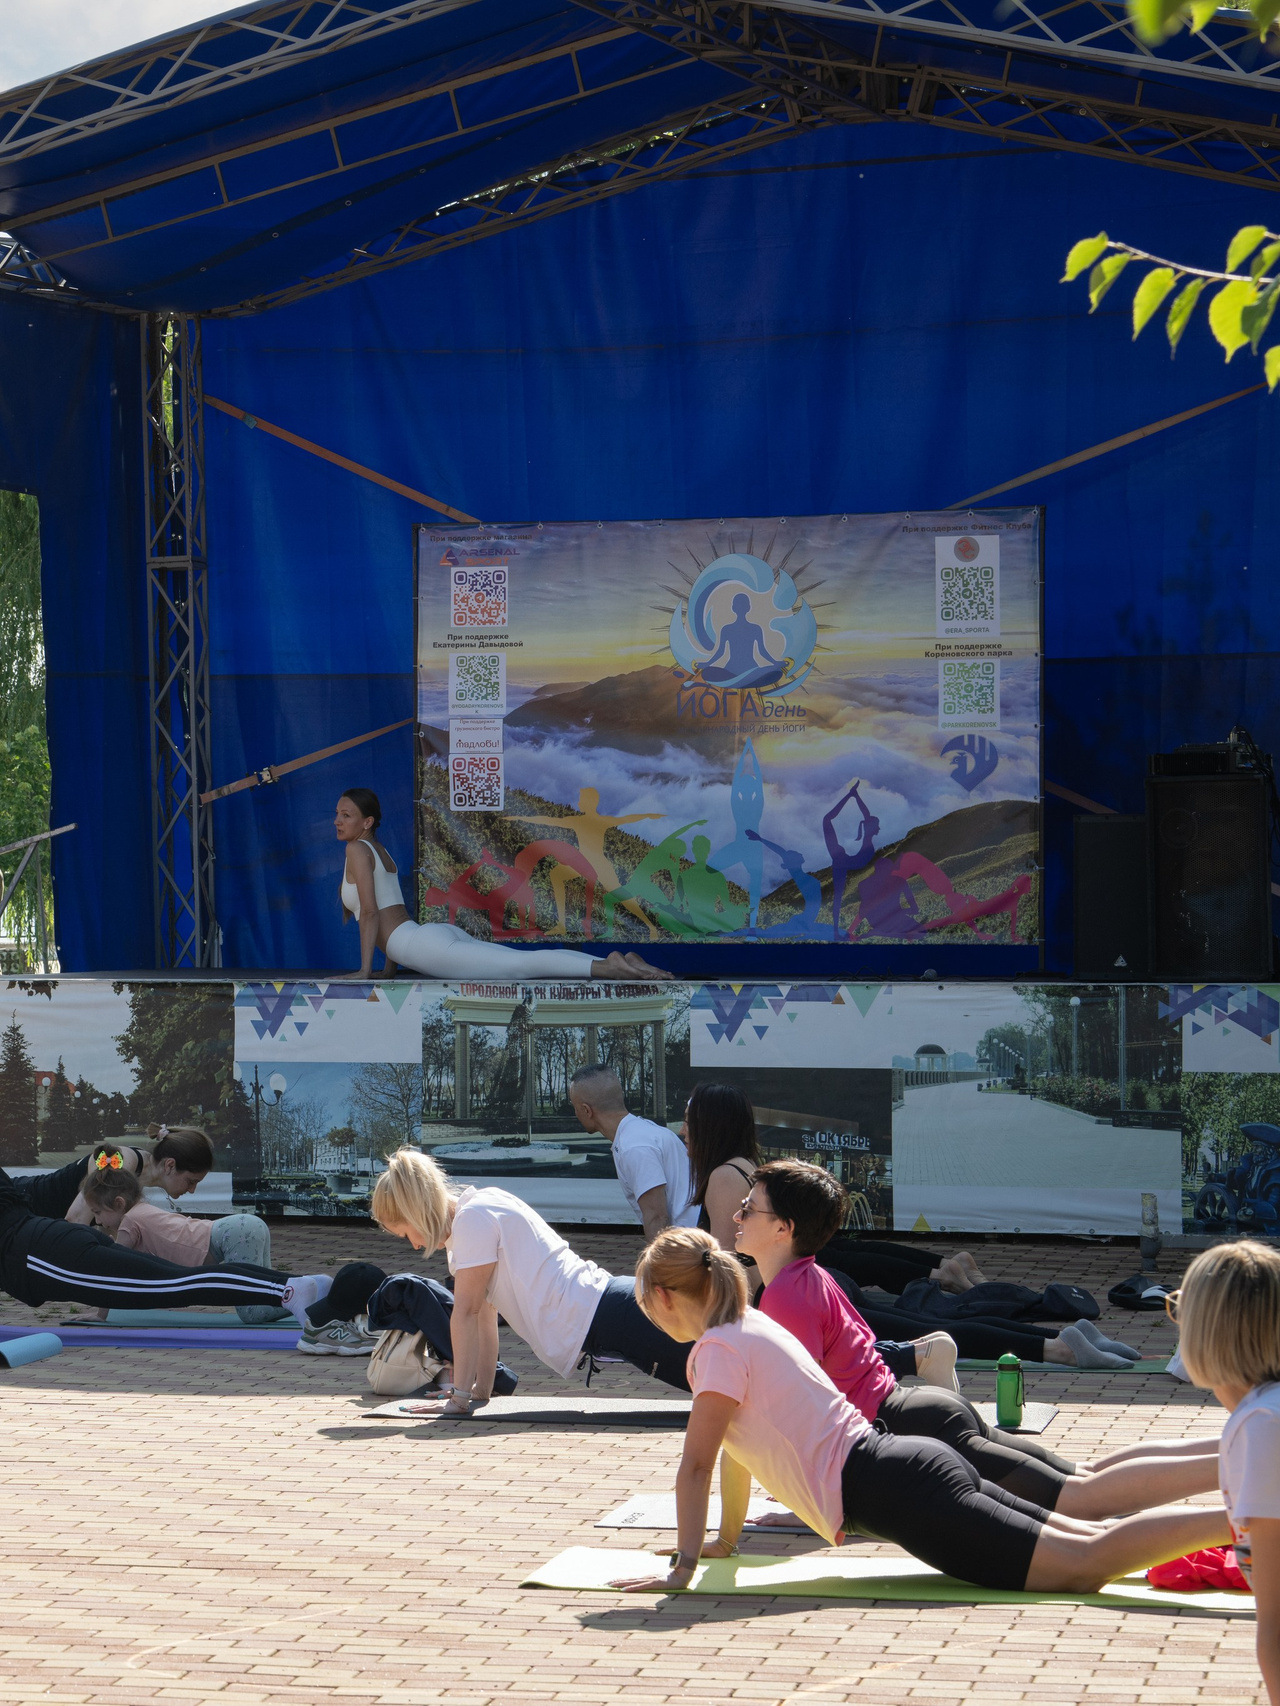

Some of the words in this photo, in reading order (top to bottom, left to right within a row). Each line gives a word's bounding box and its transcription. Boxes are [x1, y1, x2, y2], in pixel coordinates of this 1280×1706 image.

[902, 525, 919, 533] При
[921, 525, 969, 533] поддержке
[971, 523, 1003, 531] Фитнес
[1006, 522, 1032, 530] Клуба
[430, 535, 446, 543] При
[459, 548, 521, 557] ARSENAL
[465, 557, 510, 566] SPORT
[945, 627, 990, 635] @ERA_SPORTA
[465, 633, 509, 641] поддержке
[432, 641, 477, 649] Екатерины
[478, 640, 524, 649] Давыдовой
[935, 643, 952, 651] При
[924, 650, 985, 658] Кореновского
[676, 683, 759, 719] ЙОГА
[762, 700, 807, 718] день
[758, 724, 780, 734] ДЕНЬ
[782, 723, 806, 733] ЙОГИ
[941, 721, 997, 729] @PARKKORENOVSK
[460, 983, 518, 999] ГОРОДСКОЙ
[550, 985, 601, 1000] КУЛЬТУРЫ
[815, 1131, 871, 1149] ОКТЯБРЬ
